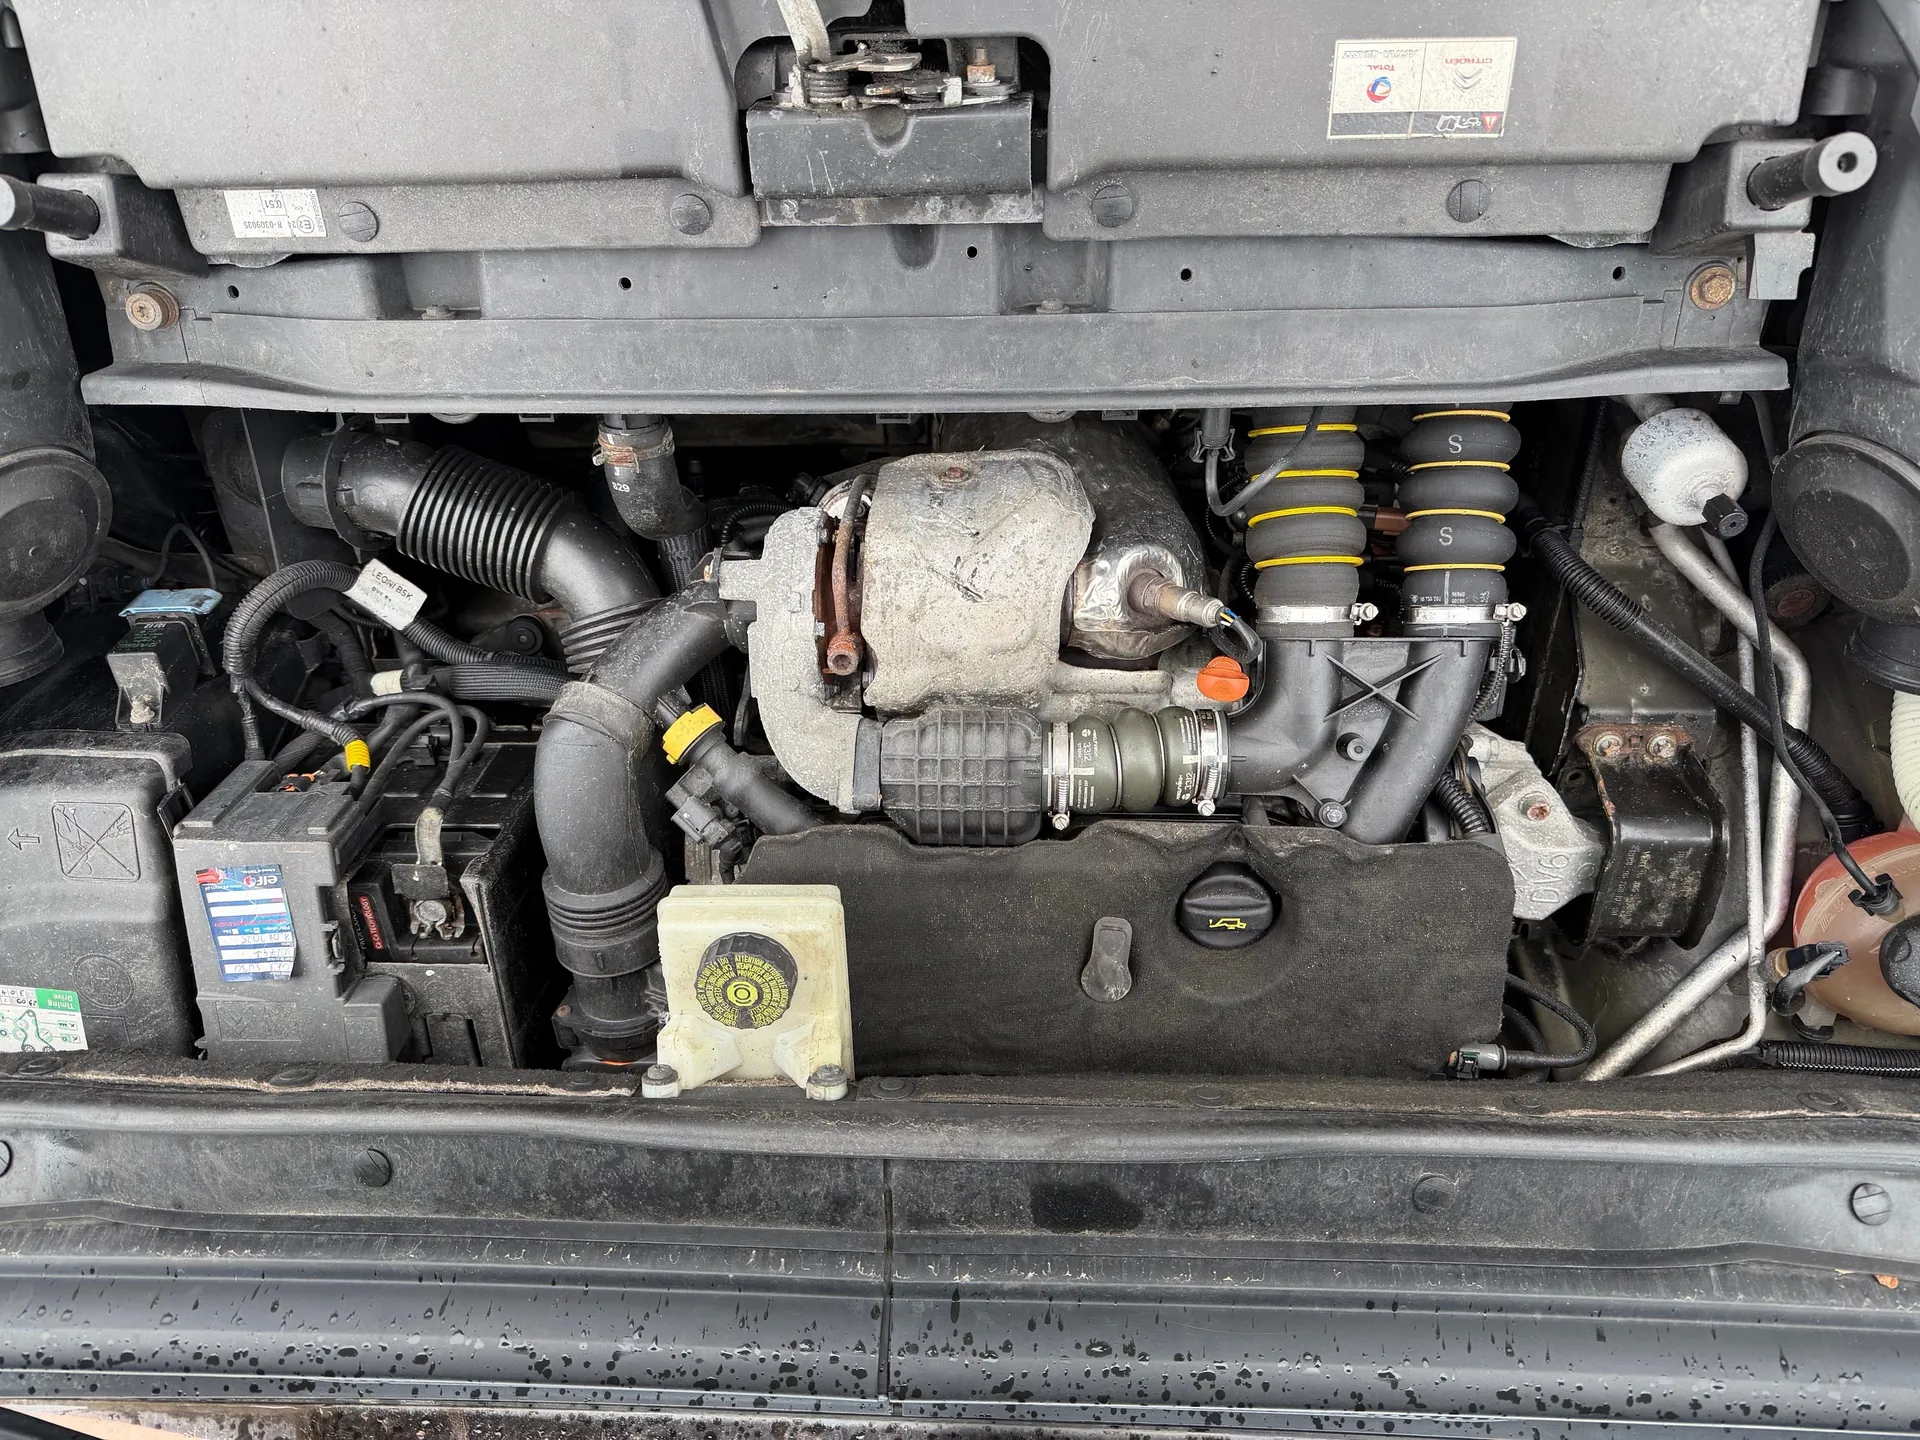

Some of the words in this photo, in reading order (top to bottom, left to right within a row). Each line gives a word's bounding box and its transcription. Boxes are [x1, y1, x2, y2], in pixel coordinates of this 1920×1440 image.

[1448, 434, 1462, 454] S
[1438, 526, 1453, 546] S
[372, 568, 396, 589] LEONI
[396, 586, 414, 601] BSK
[1083, 742, 1092, 762] 3312
[1184, 772, 1193, 790] 3312
[257, 875, 278, 886] elf
[1529, 854, 1570, 904] DV6
[47, 1000, 74, 1009] Timing
[53, 994, 73, 1002] Drive
